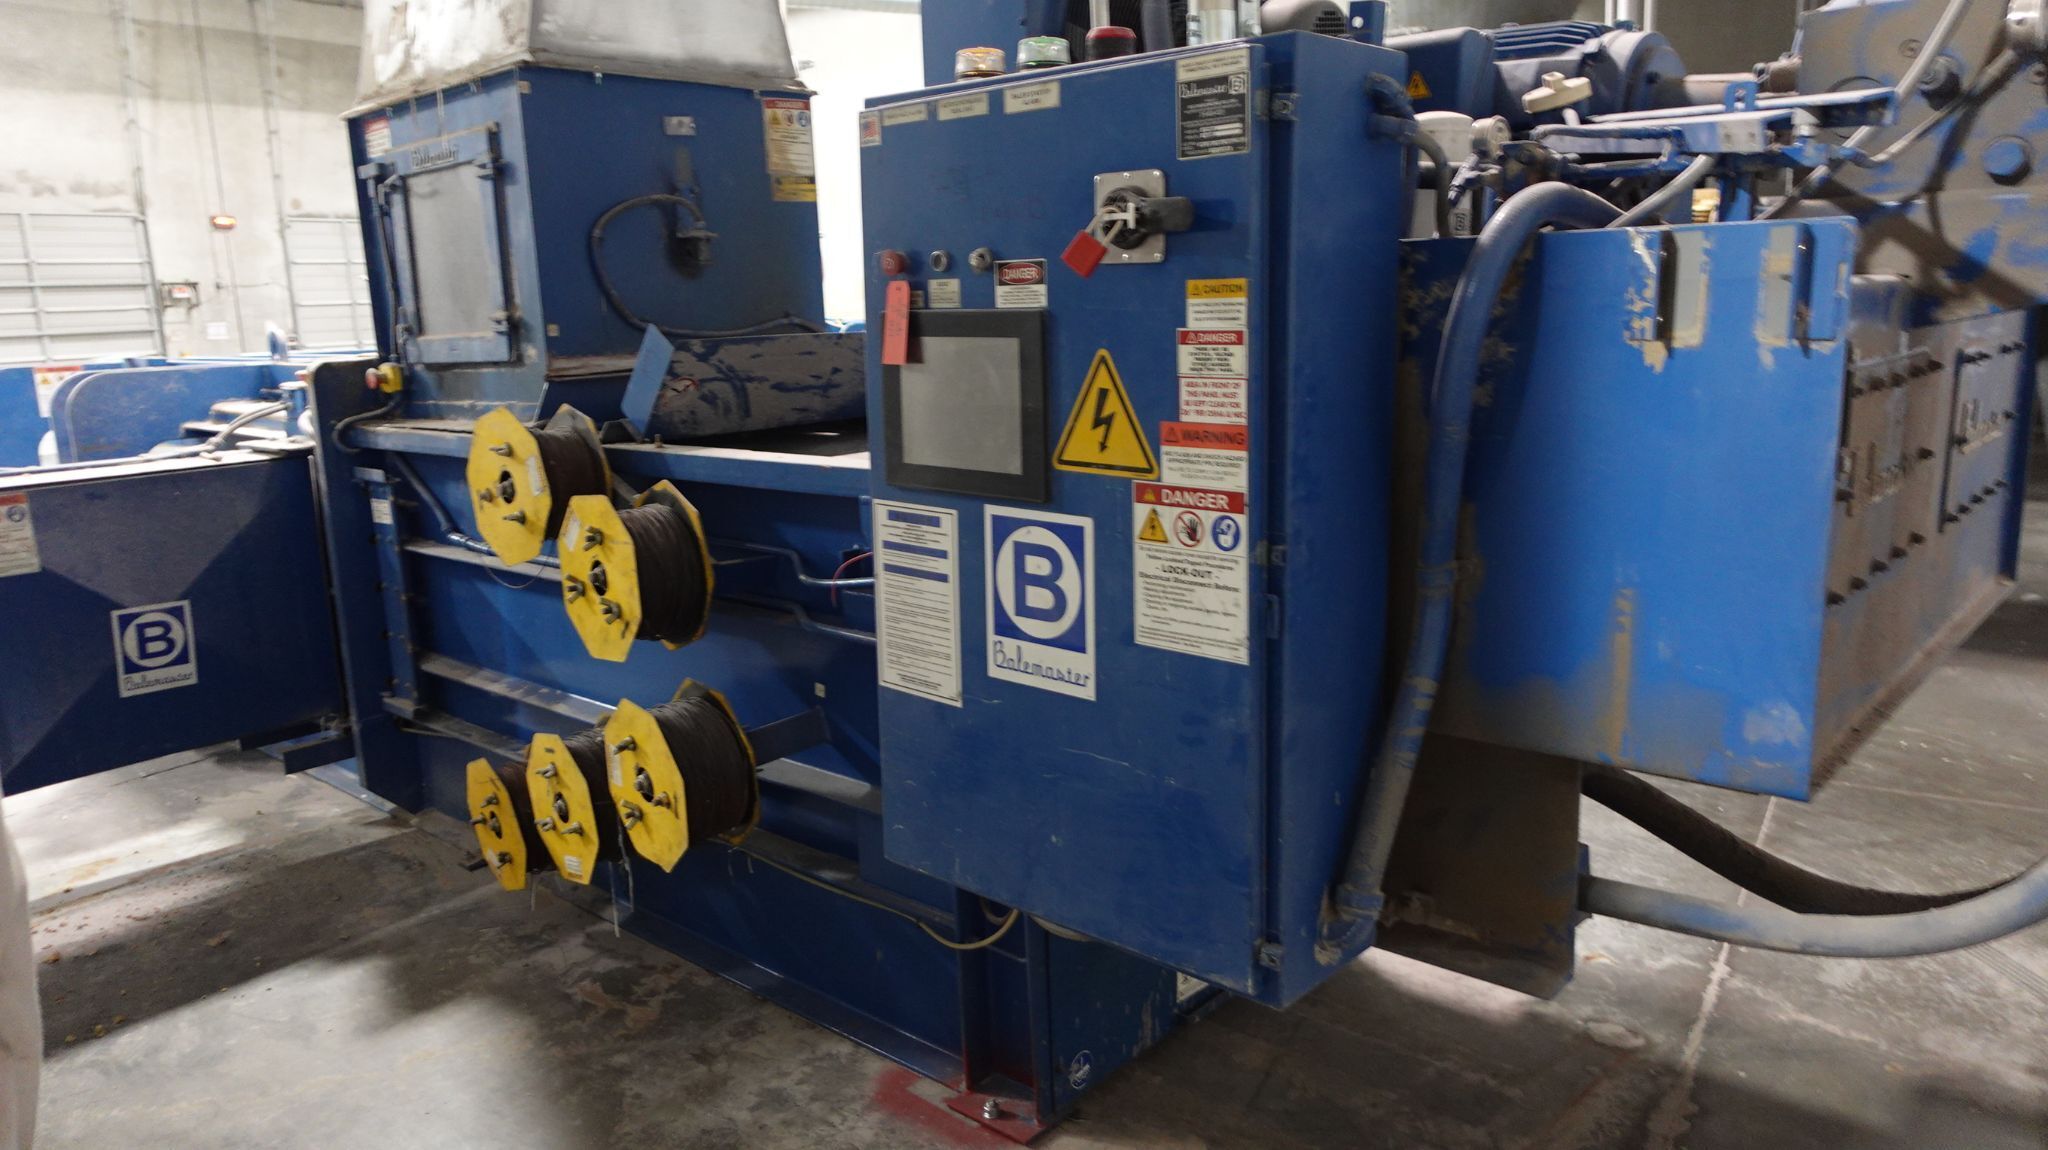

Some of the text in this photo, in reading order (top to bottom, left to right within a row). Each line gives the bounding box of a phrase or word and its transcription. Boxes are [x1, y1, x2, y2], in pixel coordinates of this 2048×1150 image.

[1002, 267, 1039, 280] DANGER
[1203, 284, 1243, 294] CAUTION
[1198, 332, 1238, 343] DANGER
[1182, 429, 1244, 445] WARNING
[1161, 488, 1230, 510] DANGER
[1013, 540, 1067, 622] B
[136, 620, 176, 660] B
[993, 640, 1092, 686] Balemaster
